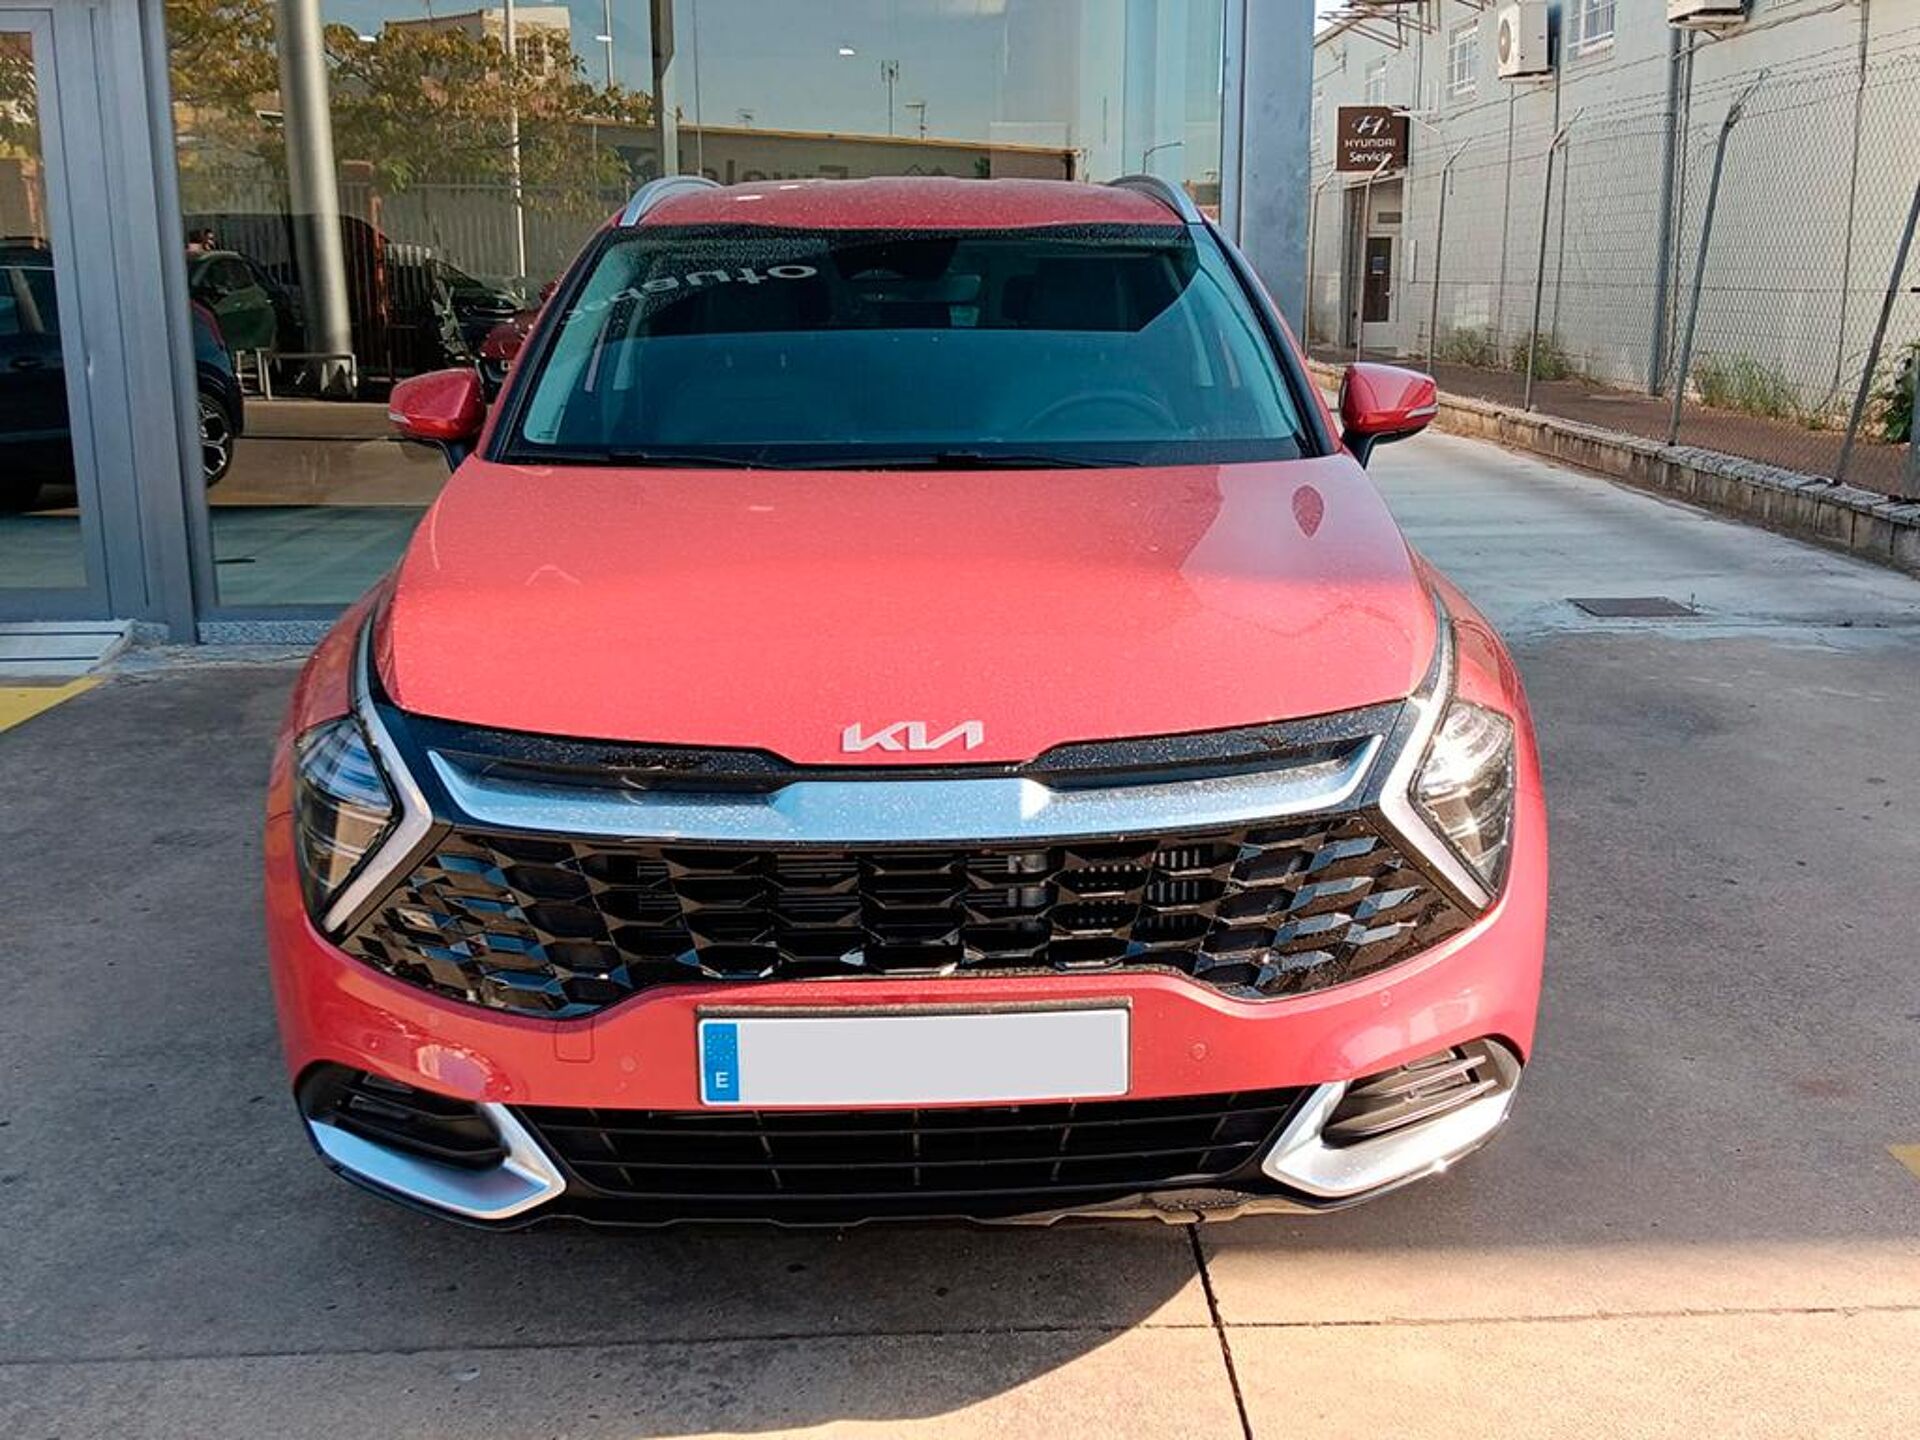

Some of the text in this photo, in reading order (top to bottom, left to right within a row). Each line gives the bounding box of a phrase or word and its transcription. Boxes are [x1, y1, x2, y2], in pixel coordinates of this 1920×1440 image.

[1344, 138, 1396, 148] HYUNDAI
[842, 721, 985, 752] KIA
[715, 1072, 729, 1088] E
